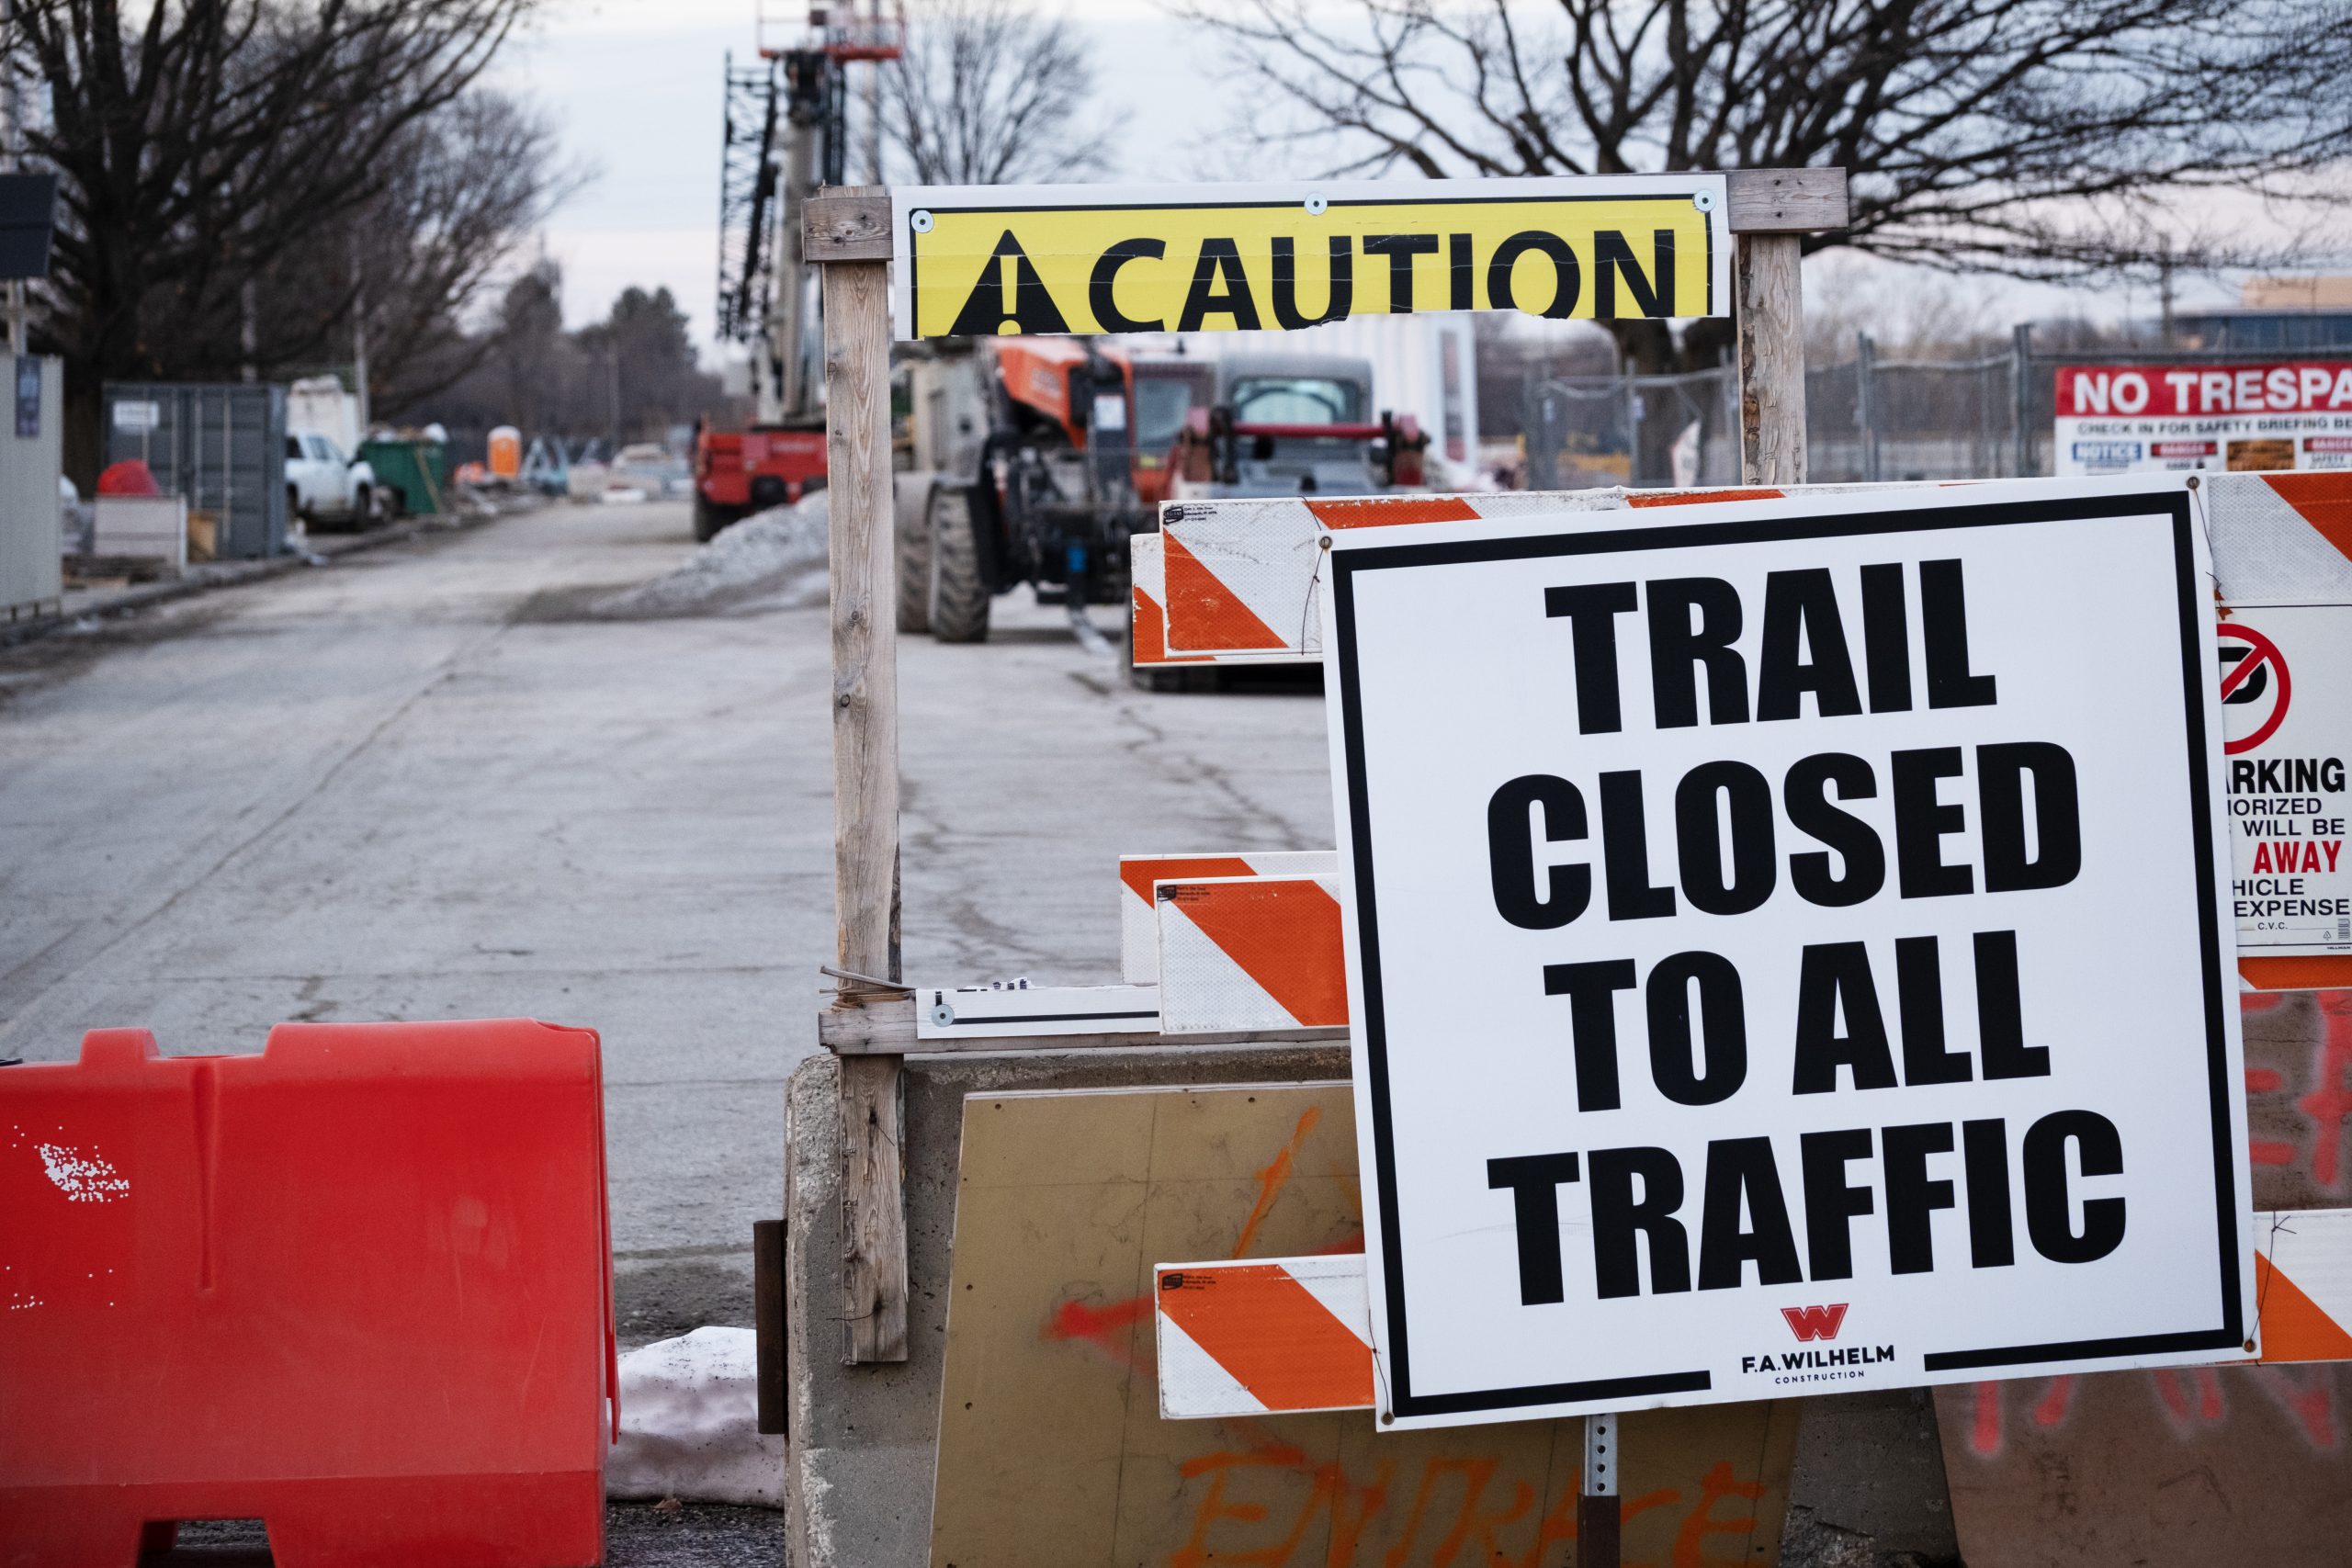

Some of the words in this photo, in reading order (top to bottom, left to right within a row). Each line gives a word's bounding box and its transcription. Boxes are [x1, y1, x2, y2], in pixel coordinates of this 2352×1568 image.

[1089, 228, 1676, 334] CAUTION
[2074, 372, 2150, 413] NO
[2077, 423, 2132, 434] CHECK
[2138, 423, 2154, 434] IN
[2159, 422, 2191, 434] FOR
[2196, 420, 2251, 433] SAFETY
[2257, 416, 2328, 430] BRIEFING
[2075, 443, 2139, 459] NOTICE
[1544, 558, 1996, 735] TRAIL
[2227, 758, 2346, 795] RKING
[2227, 798, 2323, 817] ORIZED
[1488, 742, 2081, 930] CLOSED
[2242, 819, 2302, 837] WILL
[2312, 818, 2346, 836] BE
[2253, 840, 2342, 874] AWAY
[2233, 898, 2350, 918] EXPENSE
[2257, 921, 2288, 931] C.V.C.
[1544, 951, 1747, 1111] TO
[1792, 931, 2051, 1095] ALL
[1487, 1110, 2127, 1305] TRAFFIC
[1775, 1371, 1865, 1384] CONSTRUCTION
